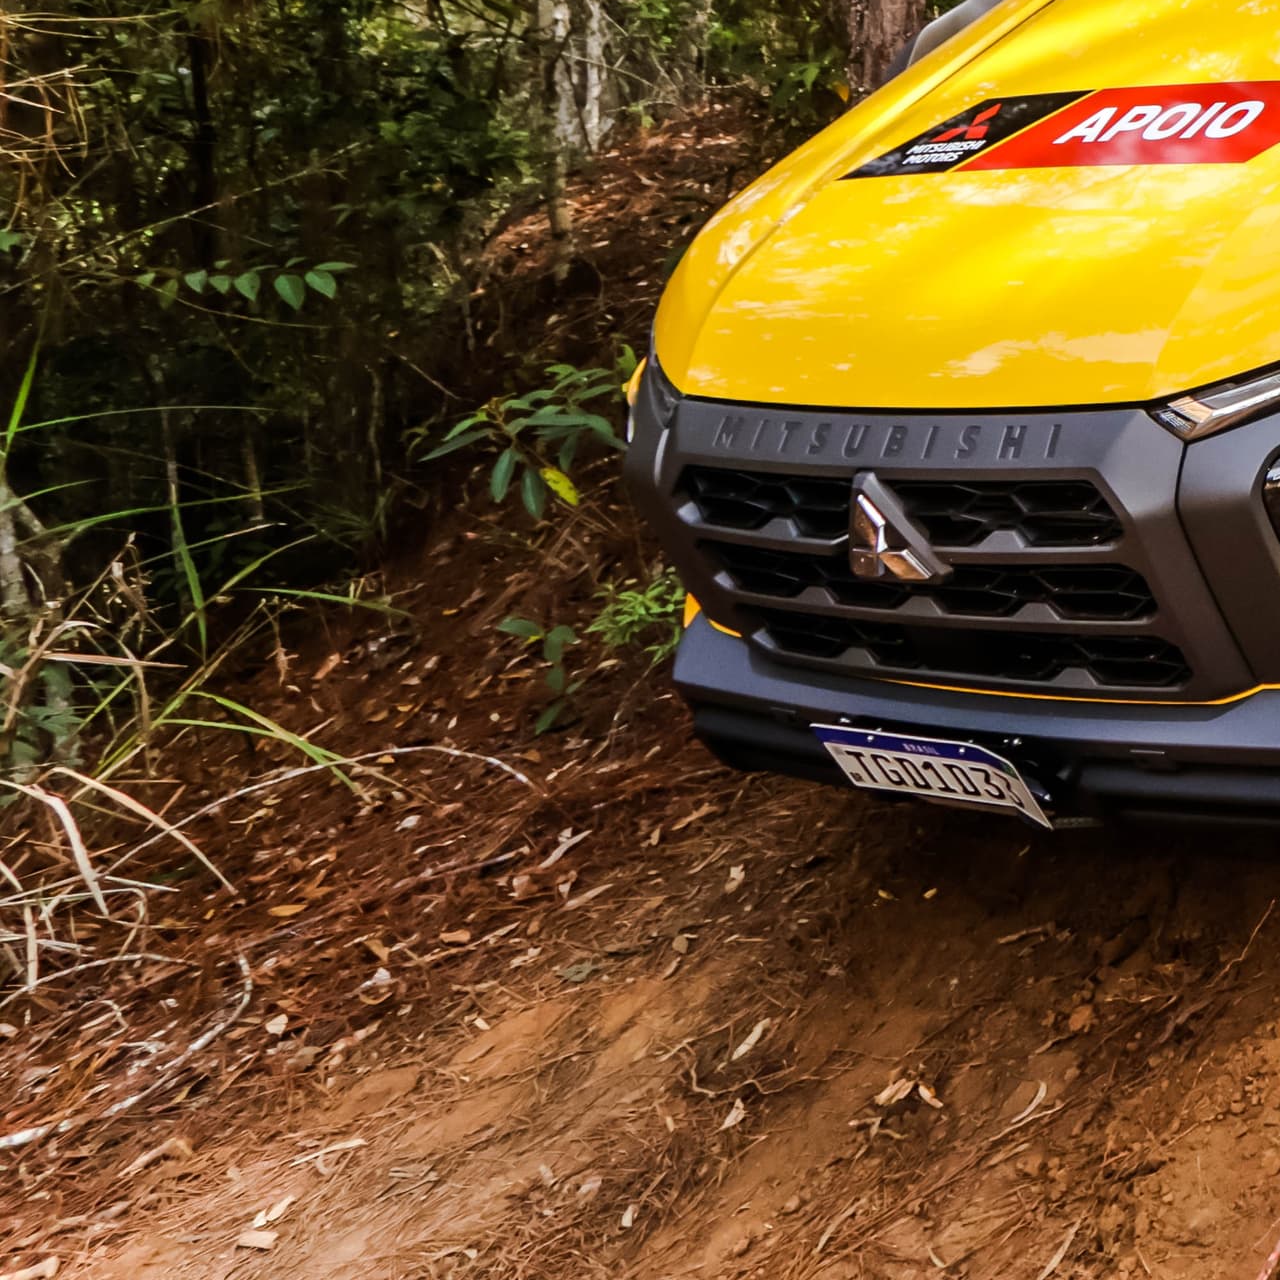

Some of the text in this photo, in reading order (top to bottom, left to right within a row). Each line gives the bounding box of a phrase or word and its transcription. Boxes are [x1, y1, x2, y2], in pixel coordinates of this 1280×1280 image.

[1052, 100, 1265, 145] APOIO
[902, 151, 964, 166] MOTORS
[905, 140, 987, 156] MITSUBISHI
[712, 415, 1063, 460] MITSUBISHI
